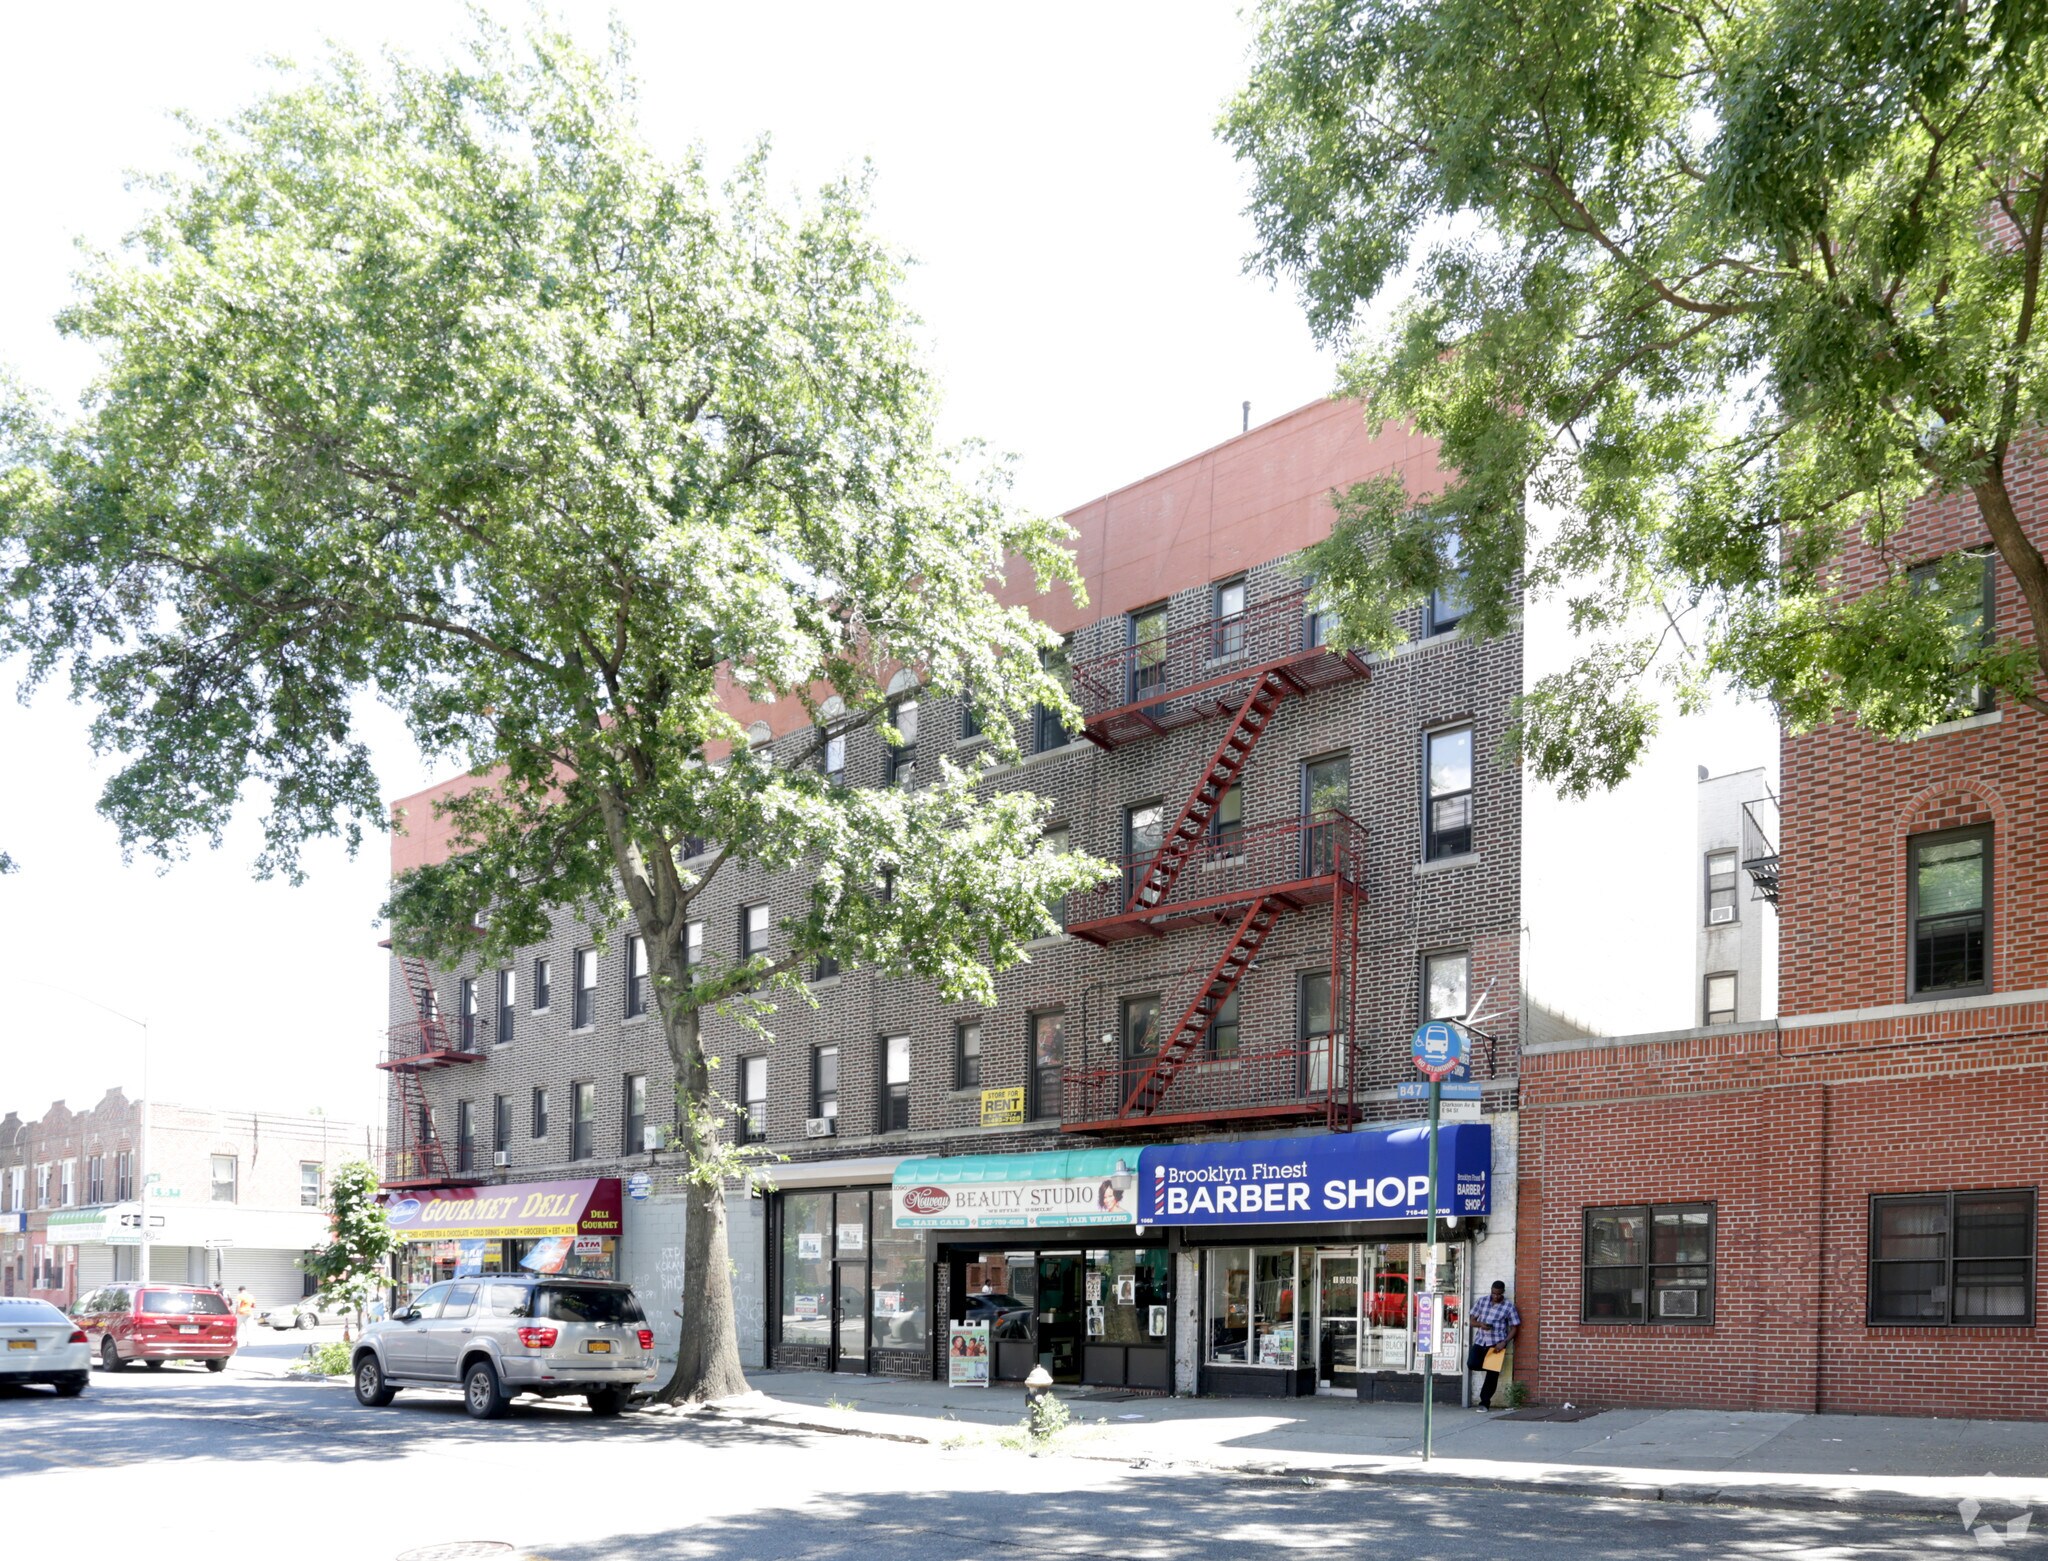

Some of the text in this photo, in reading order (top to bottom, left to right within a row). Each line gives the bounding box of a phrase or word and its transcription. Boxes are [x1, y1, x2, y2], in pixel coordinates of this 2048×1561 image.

[1416, 1058, 1426, 1068] NO
[1426, 1058, 1456, 1073] STANDING
[987, 1091, 1005, 1099] STORE
[1400, 1084, 1423, 1097] B47
[985, 1098, 1020, 1112] RENT
[1168, 1161, 1308, 1184] Brooklyn Finest
[1167, 1175, 1430, 1214] BARBER SHOP
[1457, 1183, 1481, 1196] BARBER
[903, 1186, 1093, 1212] Nouveau BEAUTY STUDIO
[1465, 1199, 1481, 1211] SHOP
[421, 1196, 518, 1222] GOURMET
[518, 1191, 579, 1218] DELI
[591, 1210, 609, 1219] DELI
[1065, 1216, 1088, 1224] HAIR
[1090, 1214, 1128, 1223] WEAVING
[581, 1220, 618, 1229] GOURMET
[939, 1218, 966, 1226] CARE
[1385, 1341, 1404, 1350] BLACK
